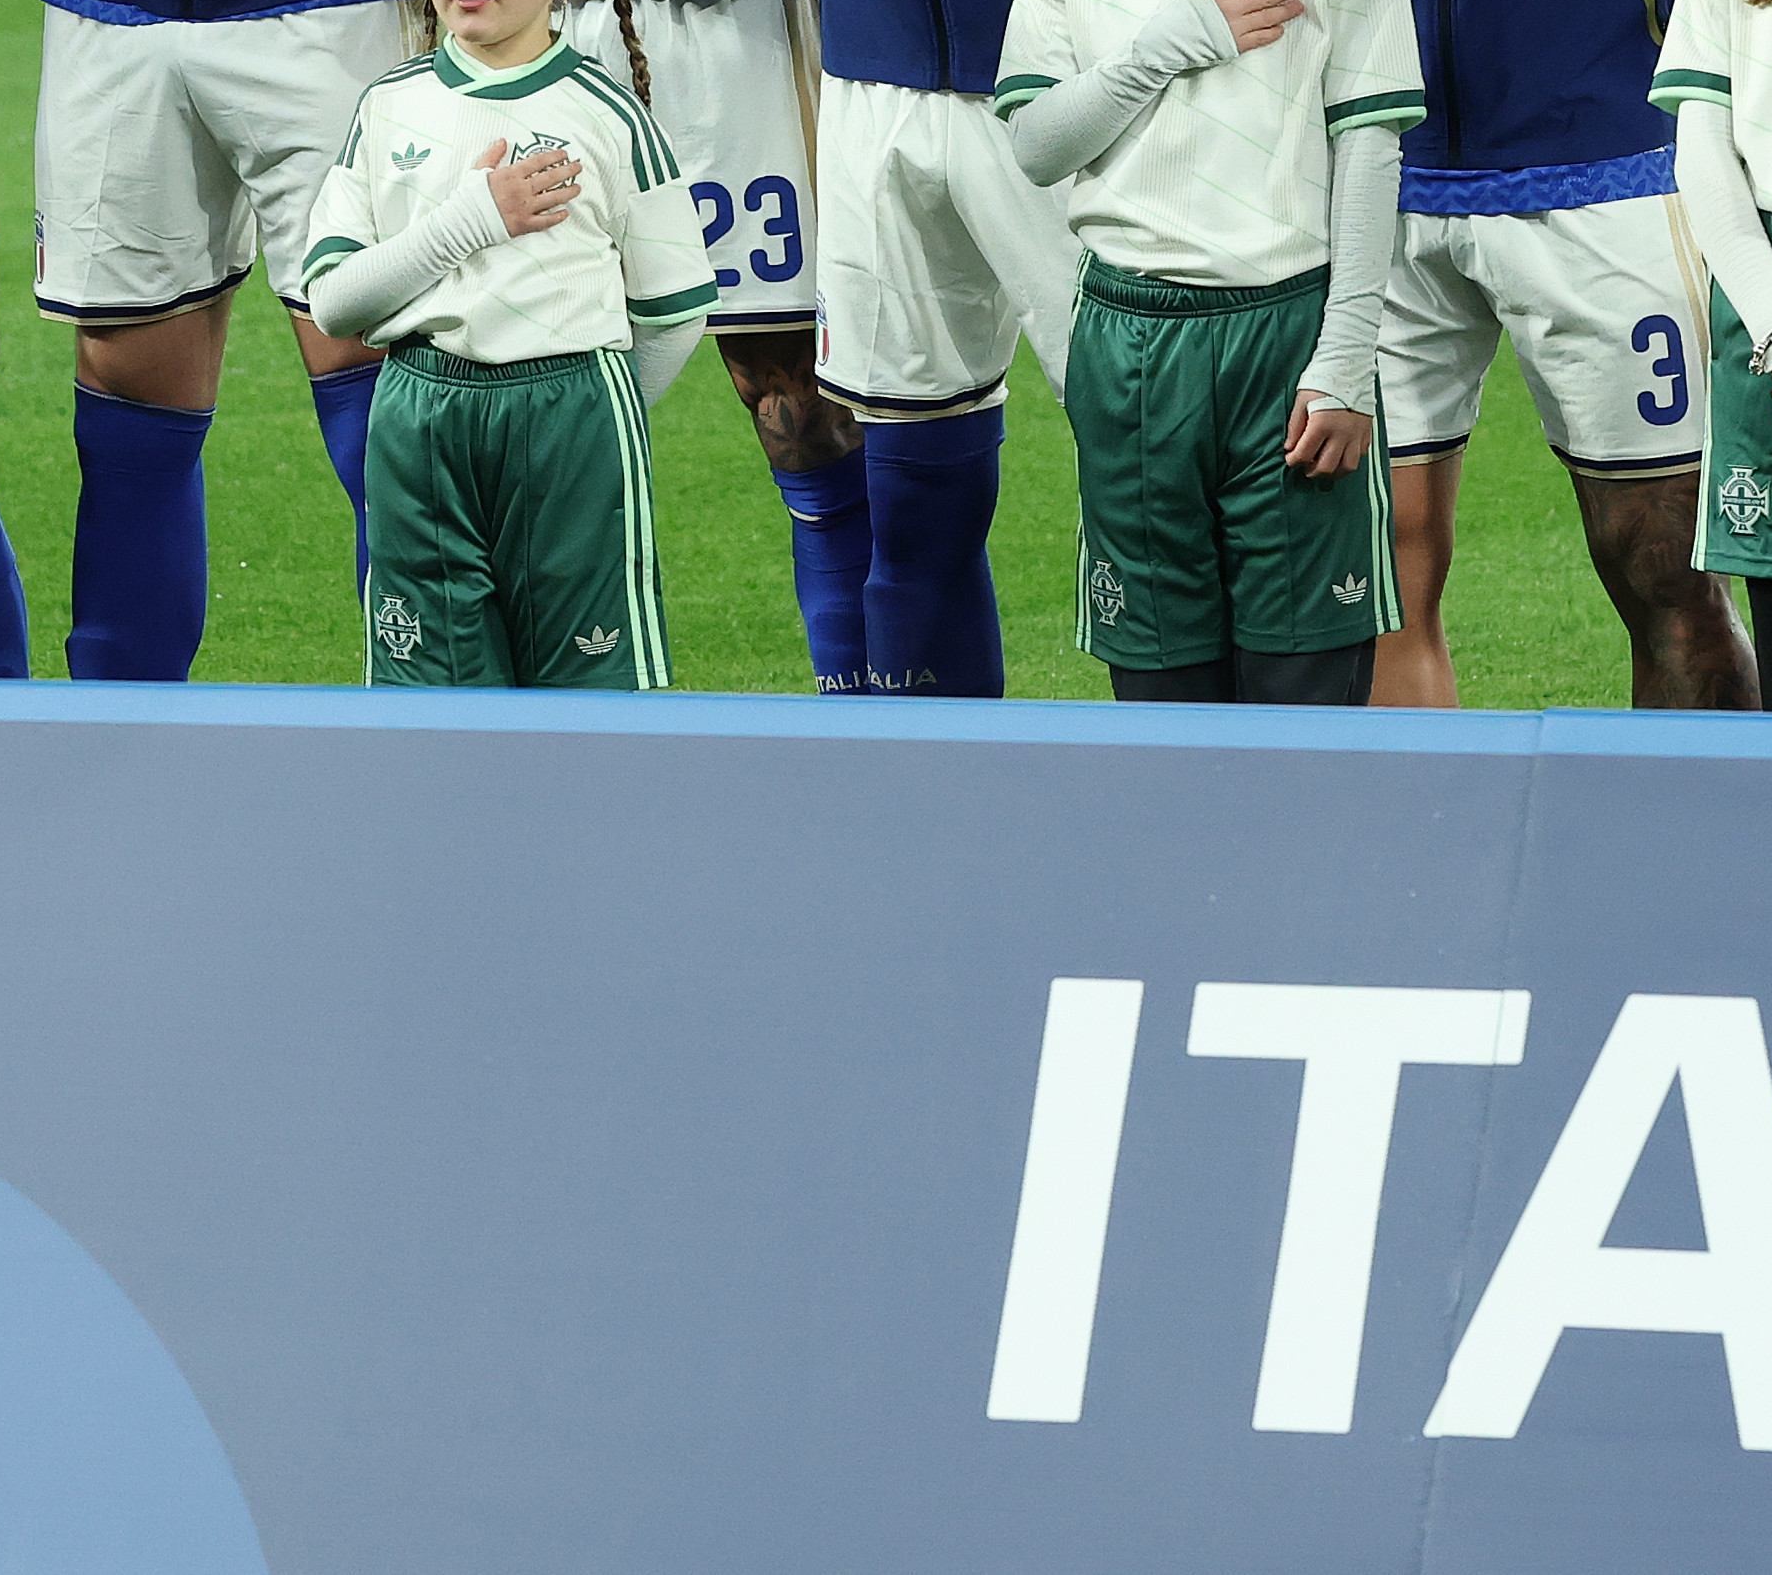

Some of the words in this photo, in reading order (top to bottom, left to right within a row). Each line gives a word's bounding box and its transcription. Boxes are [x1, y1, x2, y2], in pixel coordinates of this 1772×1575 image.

[688, 175, 804, 288] 23
[1630, 314, 1688, 426] 3
[815, 671, 869, 695] ITALI
